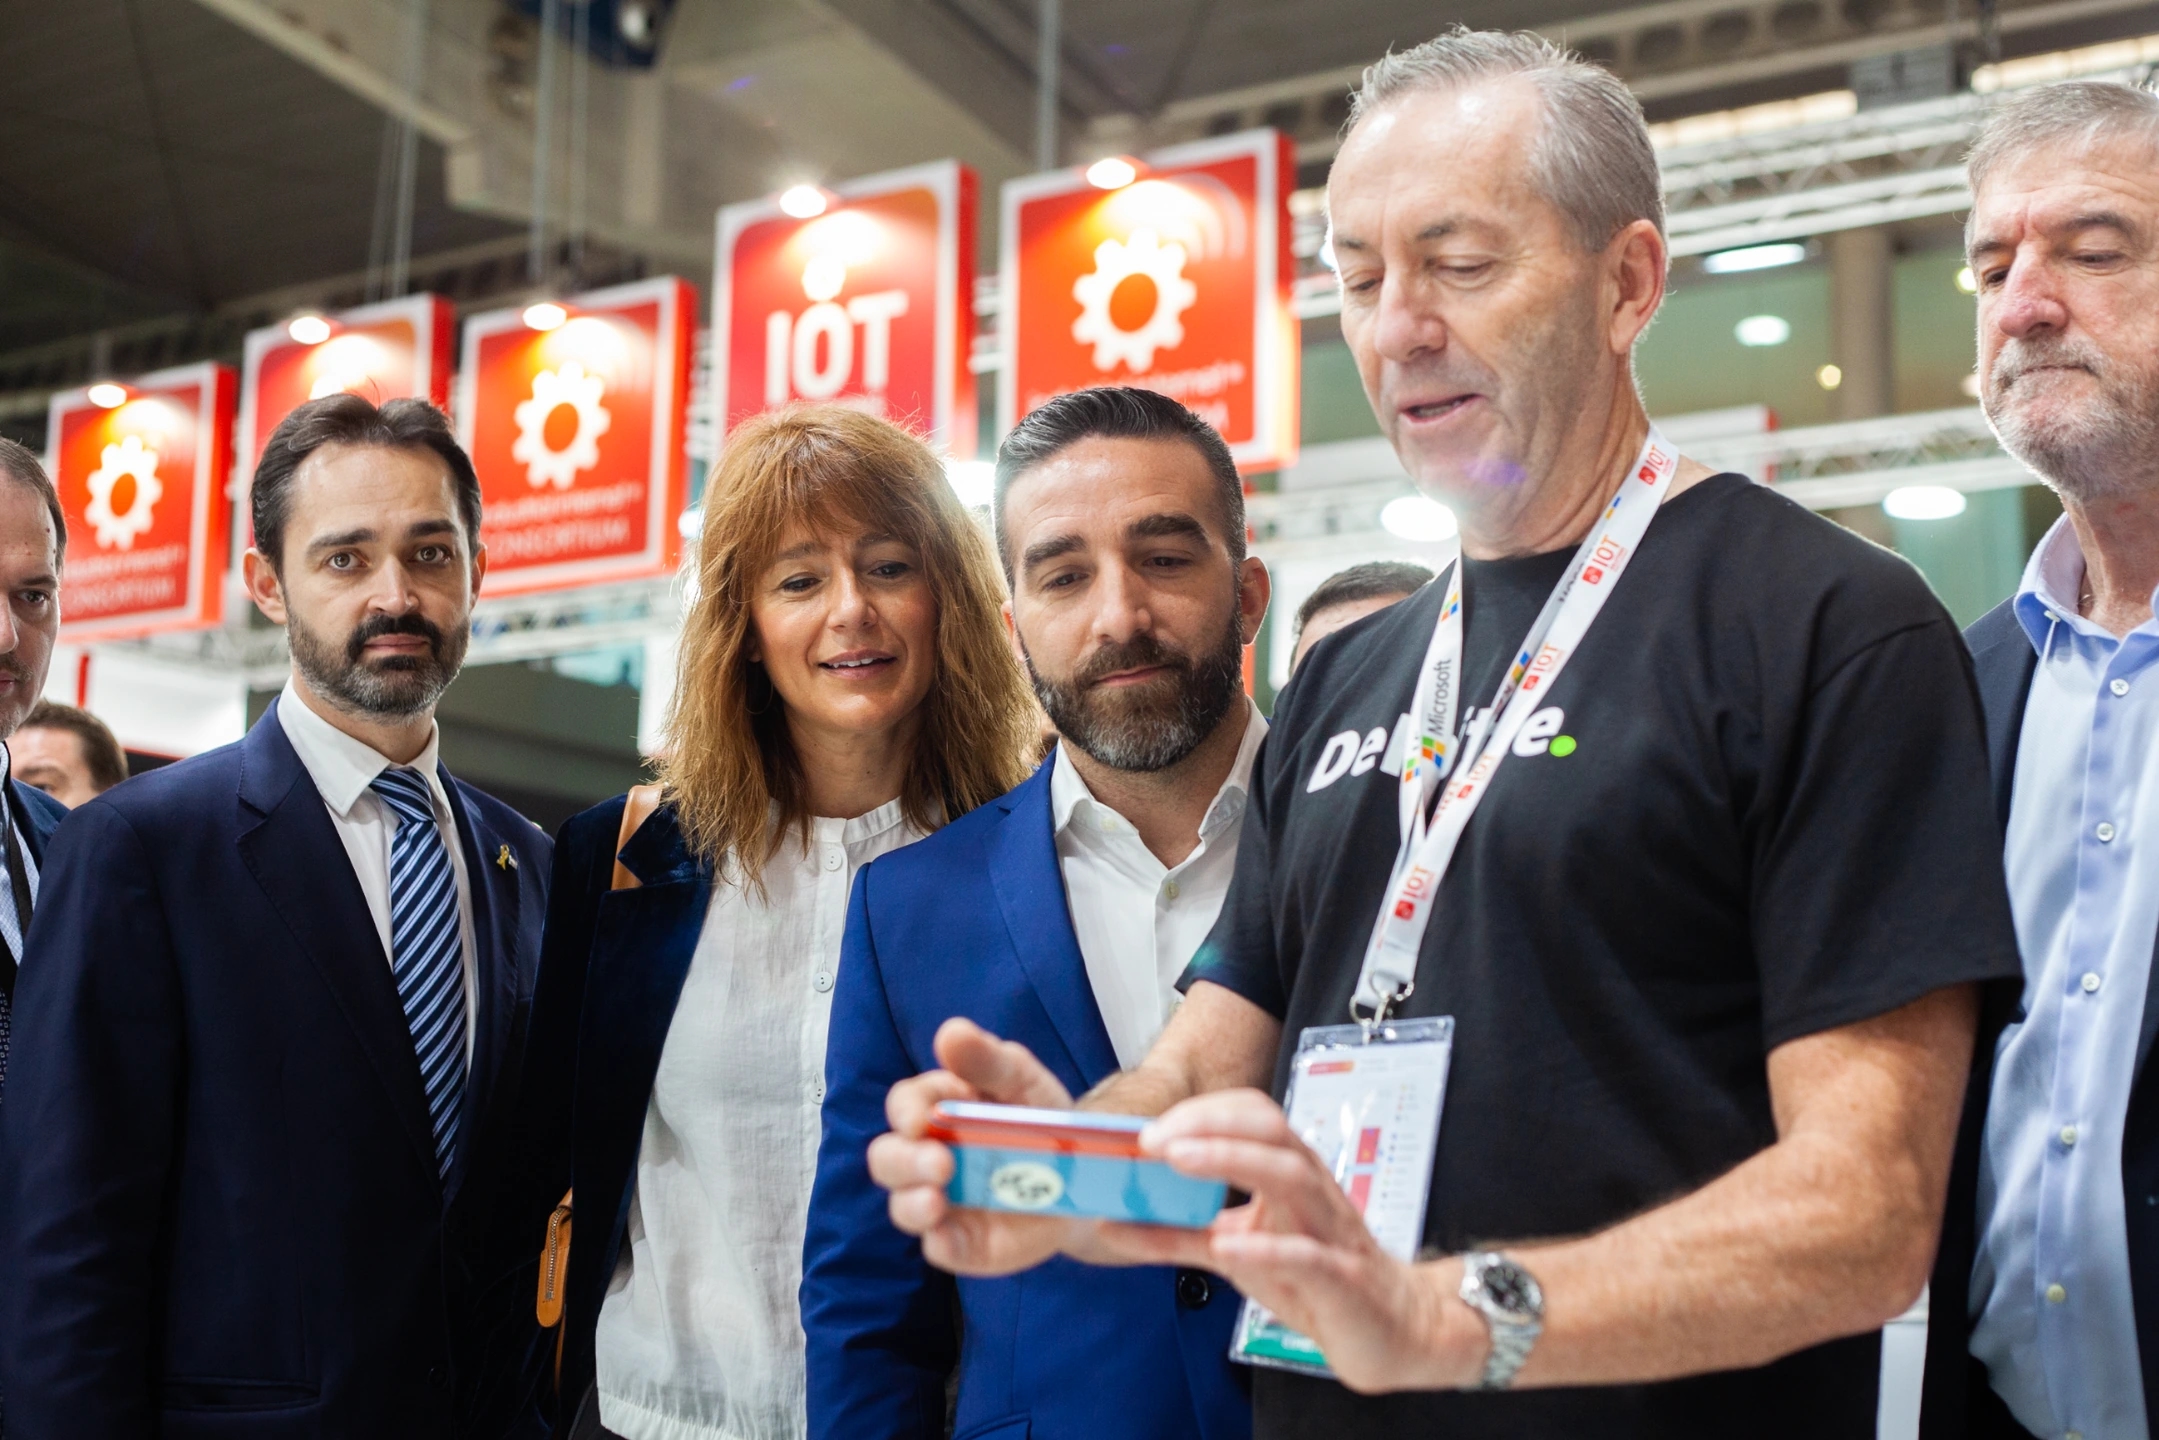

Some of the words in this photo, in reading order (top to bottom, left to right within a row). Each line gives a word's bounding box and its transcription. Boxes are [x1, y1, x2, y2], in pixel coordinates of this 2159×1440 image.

[764, 288, 910, 405] IOT
[1645, 443, 1668, 471] IOT
[1592, 535, 1620, 567] IOT
[1532, 643, 1558, 672] IOT
[1427, 658, 1452, 736] Microsoft
[1402, 864, 1428, 898] IOT
